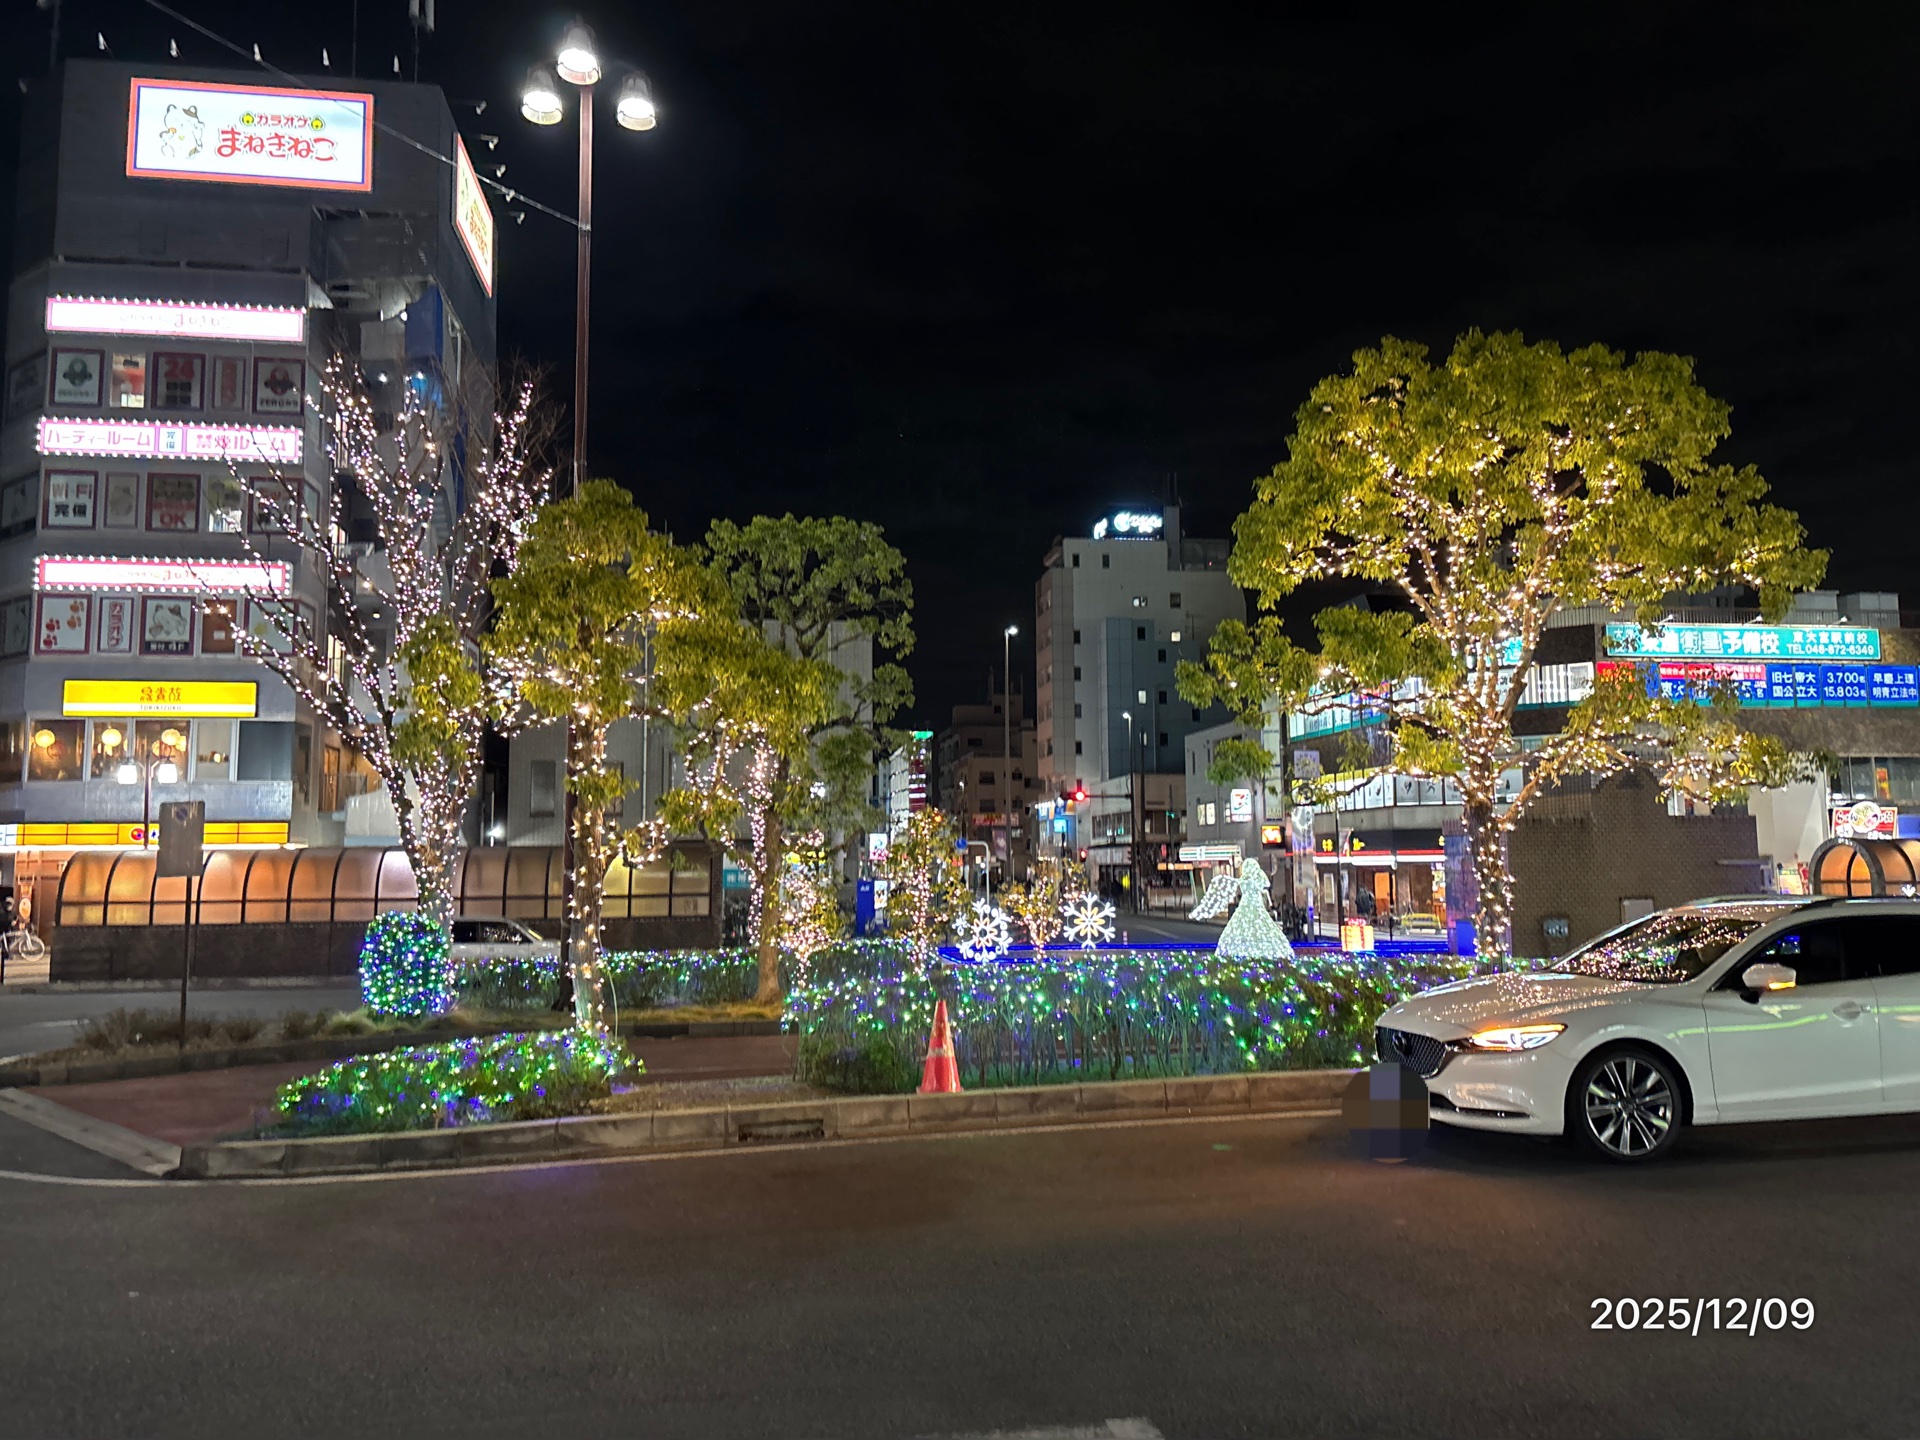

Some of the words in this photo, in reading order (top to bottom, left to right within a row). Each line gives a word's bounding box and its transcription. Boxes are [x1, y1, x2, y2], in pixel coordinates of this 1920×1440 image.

[257, 113, 310, 129] カラオケ
[216, 127, 336, 162] まねきねこ
[1792, 632, 1868, 645] 東大宮駅前校
[1772, 672, 1816, 684] 旧七帝大
[1873, 673, 1915, 685] 早慶上理
[1772, 686, 1818, 698] 国公立大
